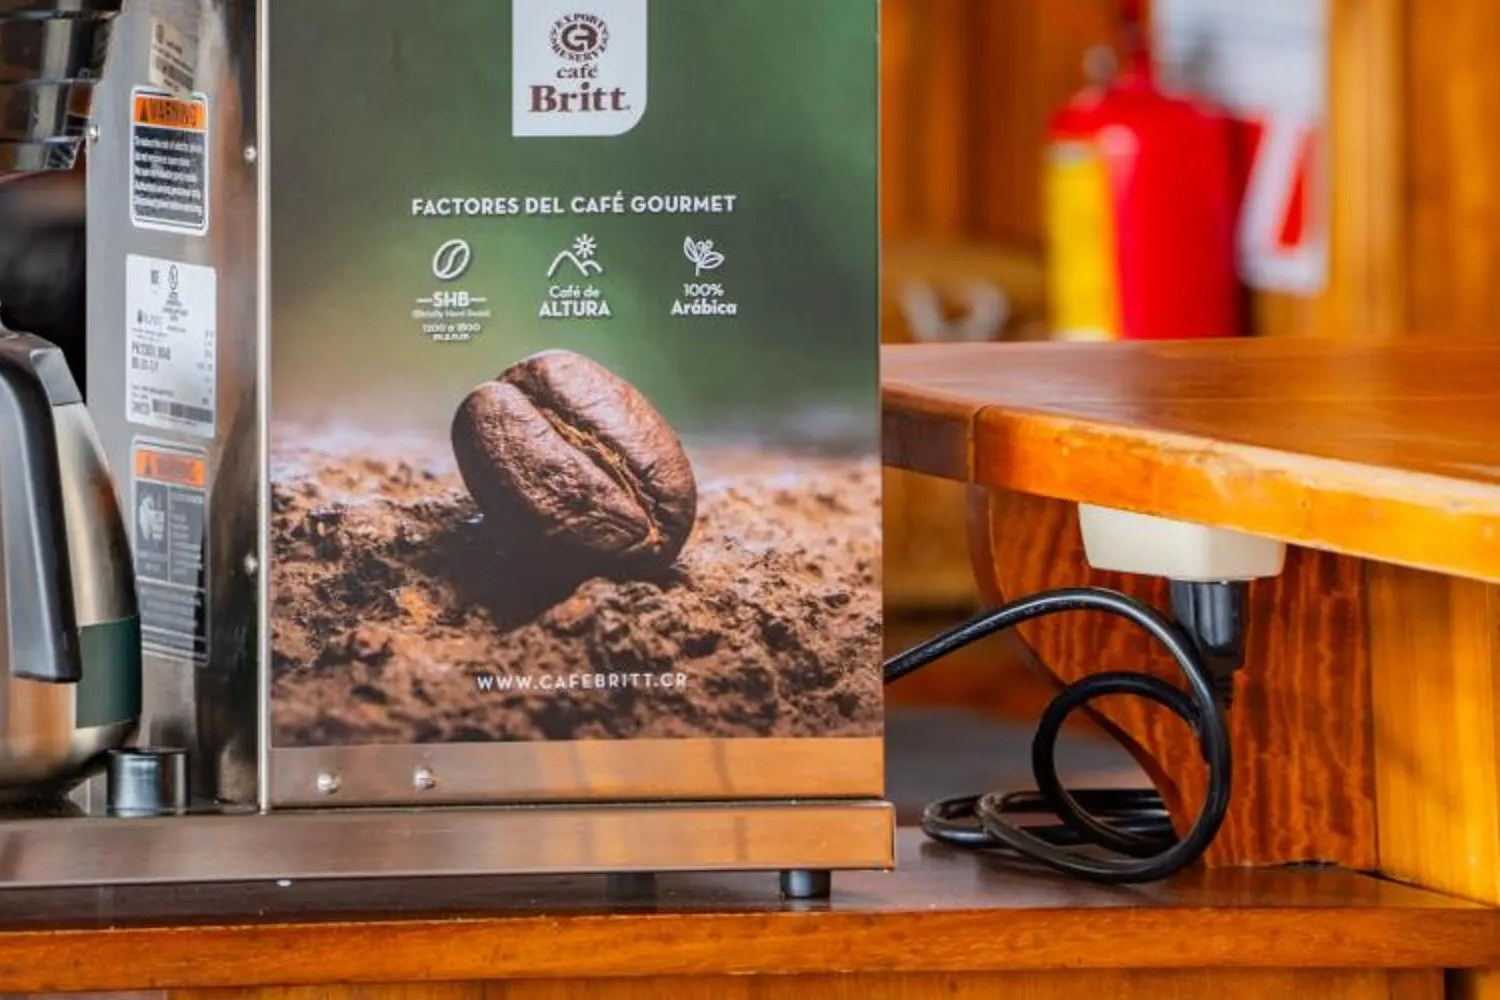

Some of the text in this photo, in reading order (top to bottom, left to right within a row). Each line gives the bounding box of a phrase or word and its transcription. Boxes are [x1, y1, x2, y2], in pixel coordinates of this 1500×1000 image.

[556, 63, 599, 79] café
[411, 190, 737, 216] FACTORES DEL CAFÉ GOURMET
[549, 284, 602, 299] Café de
[683, 283, 725, 298] 100%
[432, 291, 470, 308] SHB
[538, 299, 612, 317] ALTURA
[670, 297, 739, 316] Arábica
[476, 671, 688, 691] WWW.CAFEBRITT.CR
